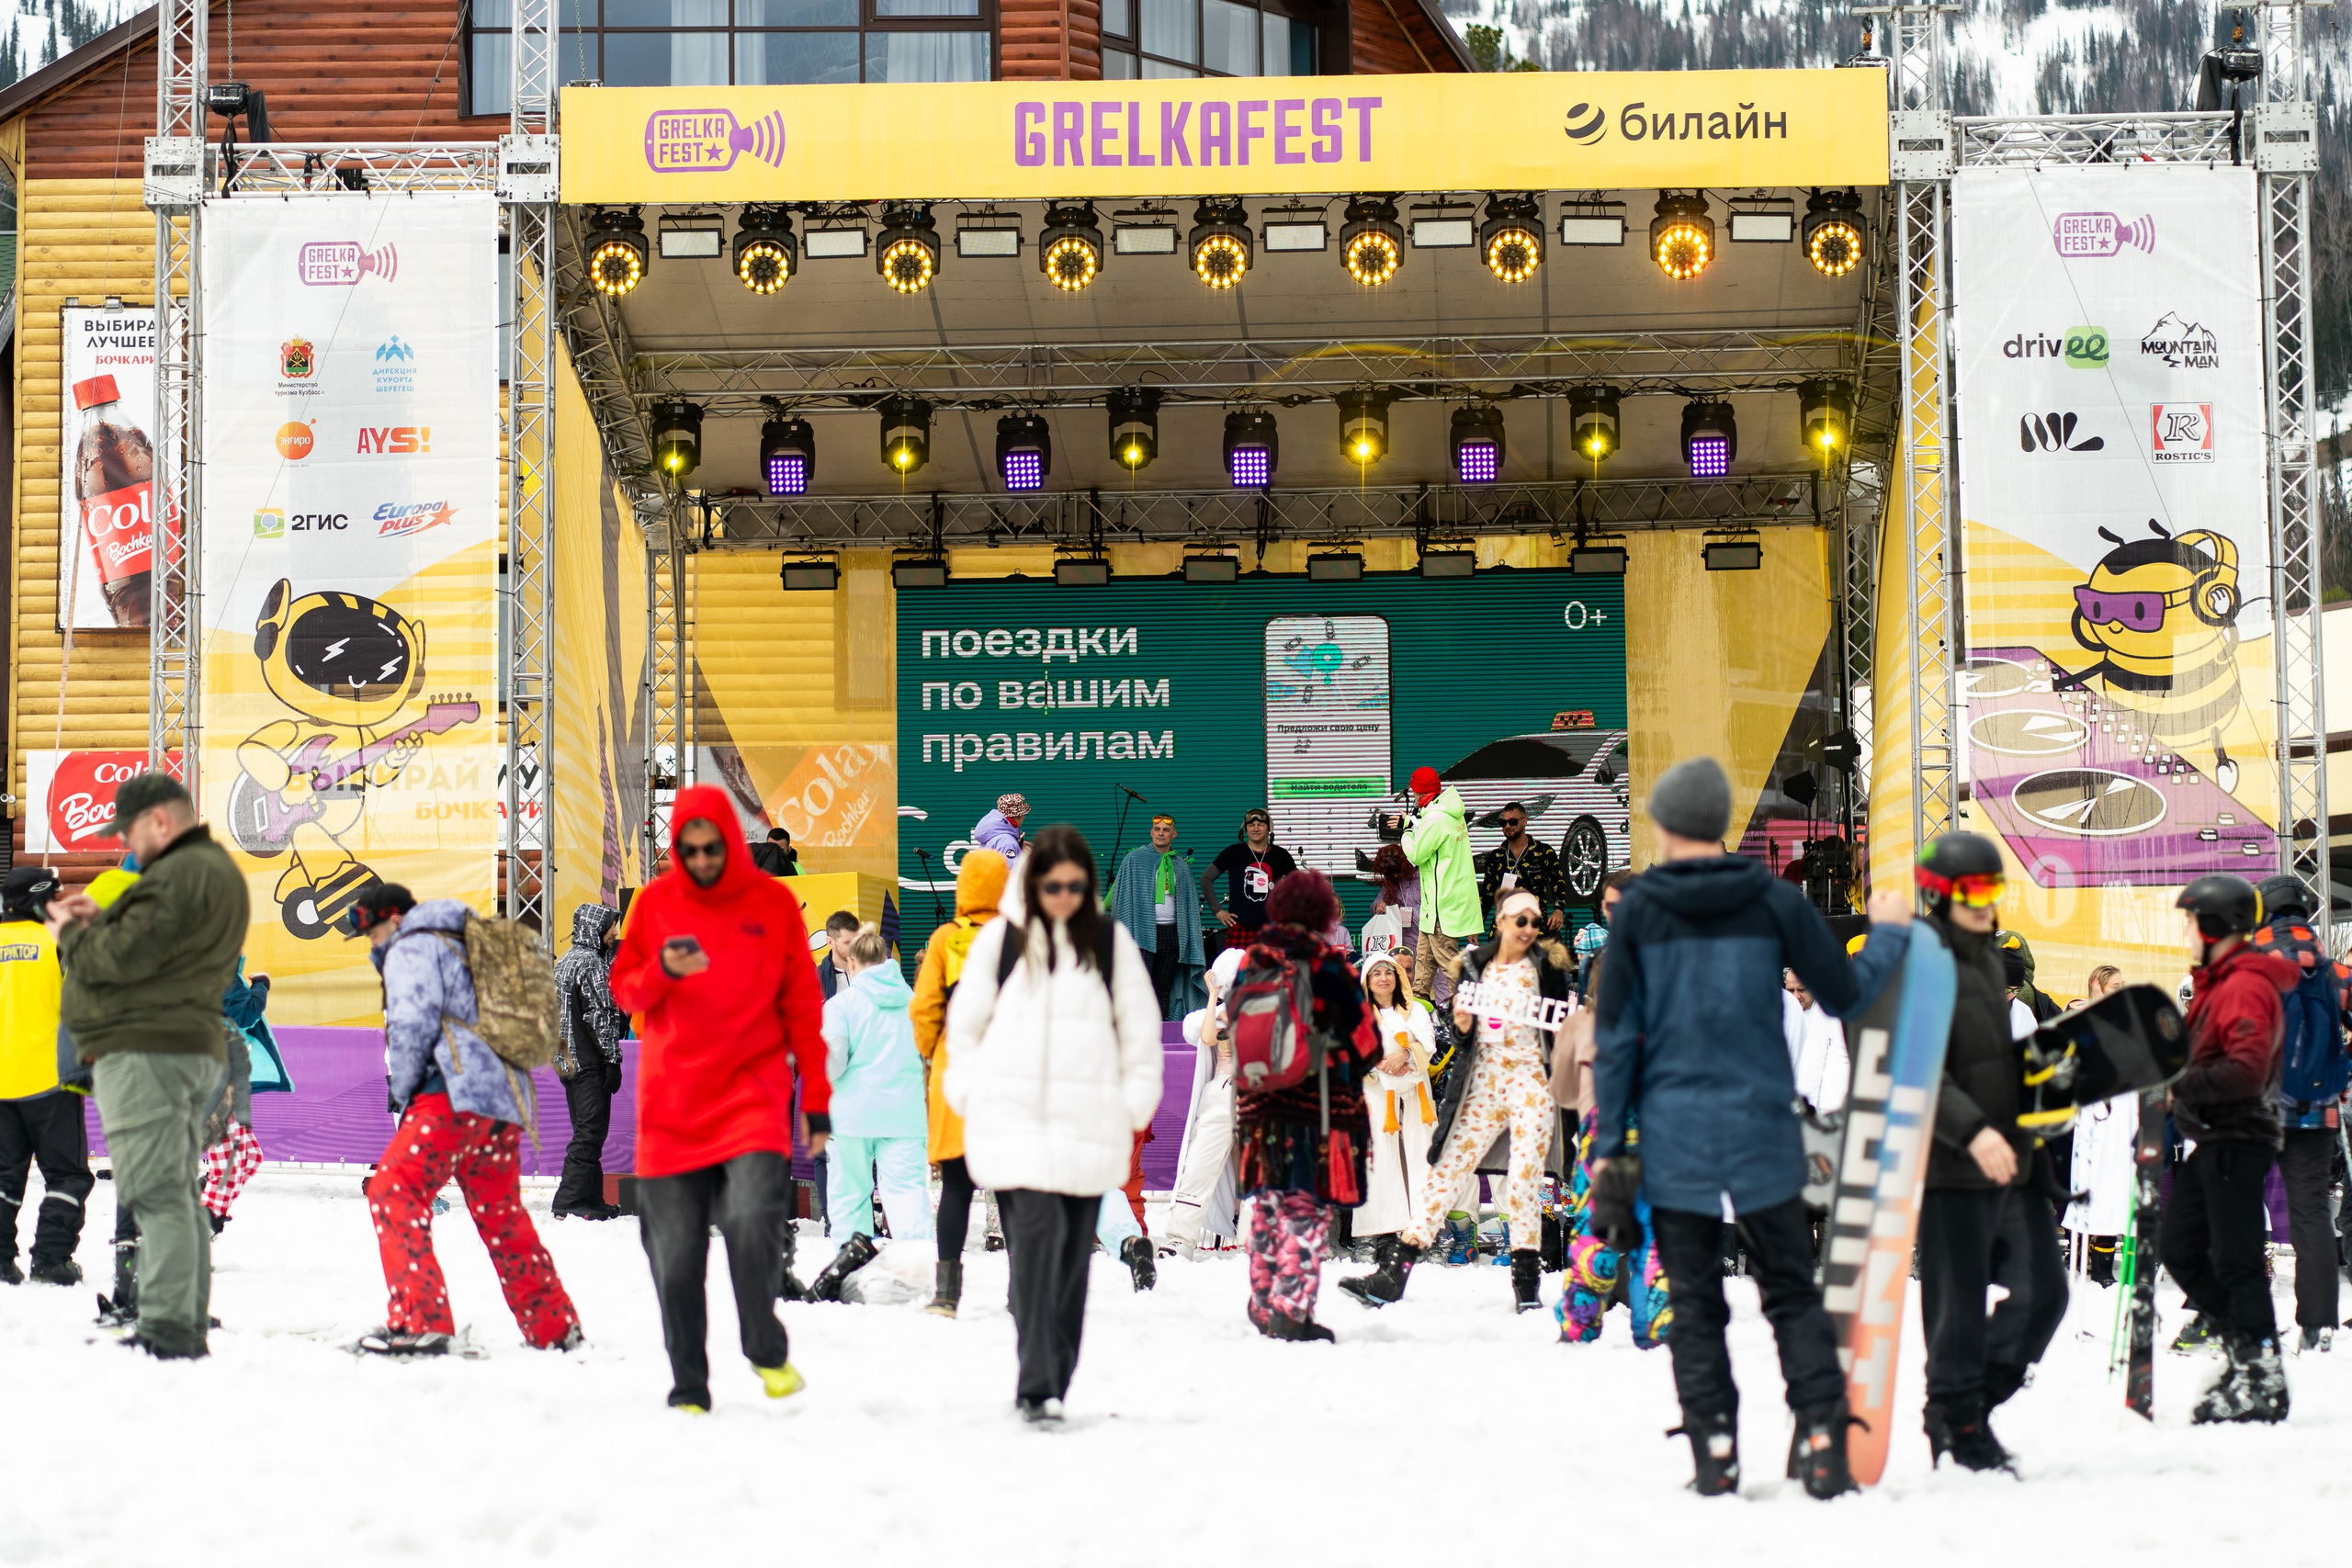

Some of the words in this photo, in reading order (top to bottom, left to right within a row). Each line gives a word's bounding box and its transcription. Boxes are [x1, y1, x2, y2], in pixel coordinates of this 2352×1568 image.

[659, 118, 725, 140] GRELKA
[1014, 96, 1383, 167] GRELKAFEST
[1620, 101, 1787, 141] билайн
[659, 142, 704, 164] FEST
[2064, 219, 2111, 233] GRELKA
[2064, 236, 2096, 251] FEST
[309, 248, 355, 263] GRELKA
[309, 265, 340, 279] FEST
[2003, 333, 2109, 360] drivee
[2142, 340, 2217, 355] MOUNTAIN
[2184, 355, 2219, 368] MAN
[280, 435, 311, 446] энгиро
[357, 426, 431, 454] AYS!
[291, 513, 348, 531] 2ГИС
[1565, 601, 1608, 629] 0+
[922, 626, 1138, 663] поездки
[922, 681, 983, 710] по
[999, 678, 1170, 708] вашим
[1277, 724, 1328, 734] Предложи
[1356, 724, 1380, 732] цену
[922, 730, 1174, 773] правилам
[777, 745, 868, 841] Cola
[1291, 783, 1321, 791] Найти
